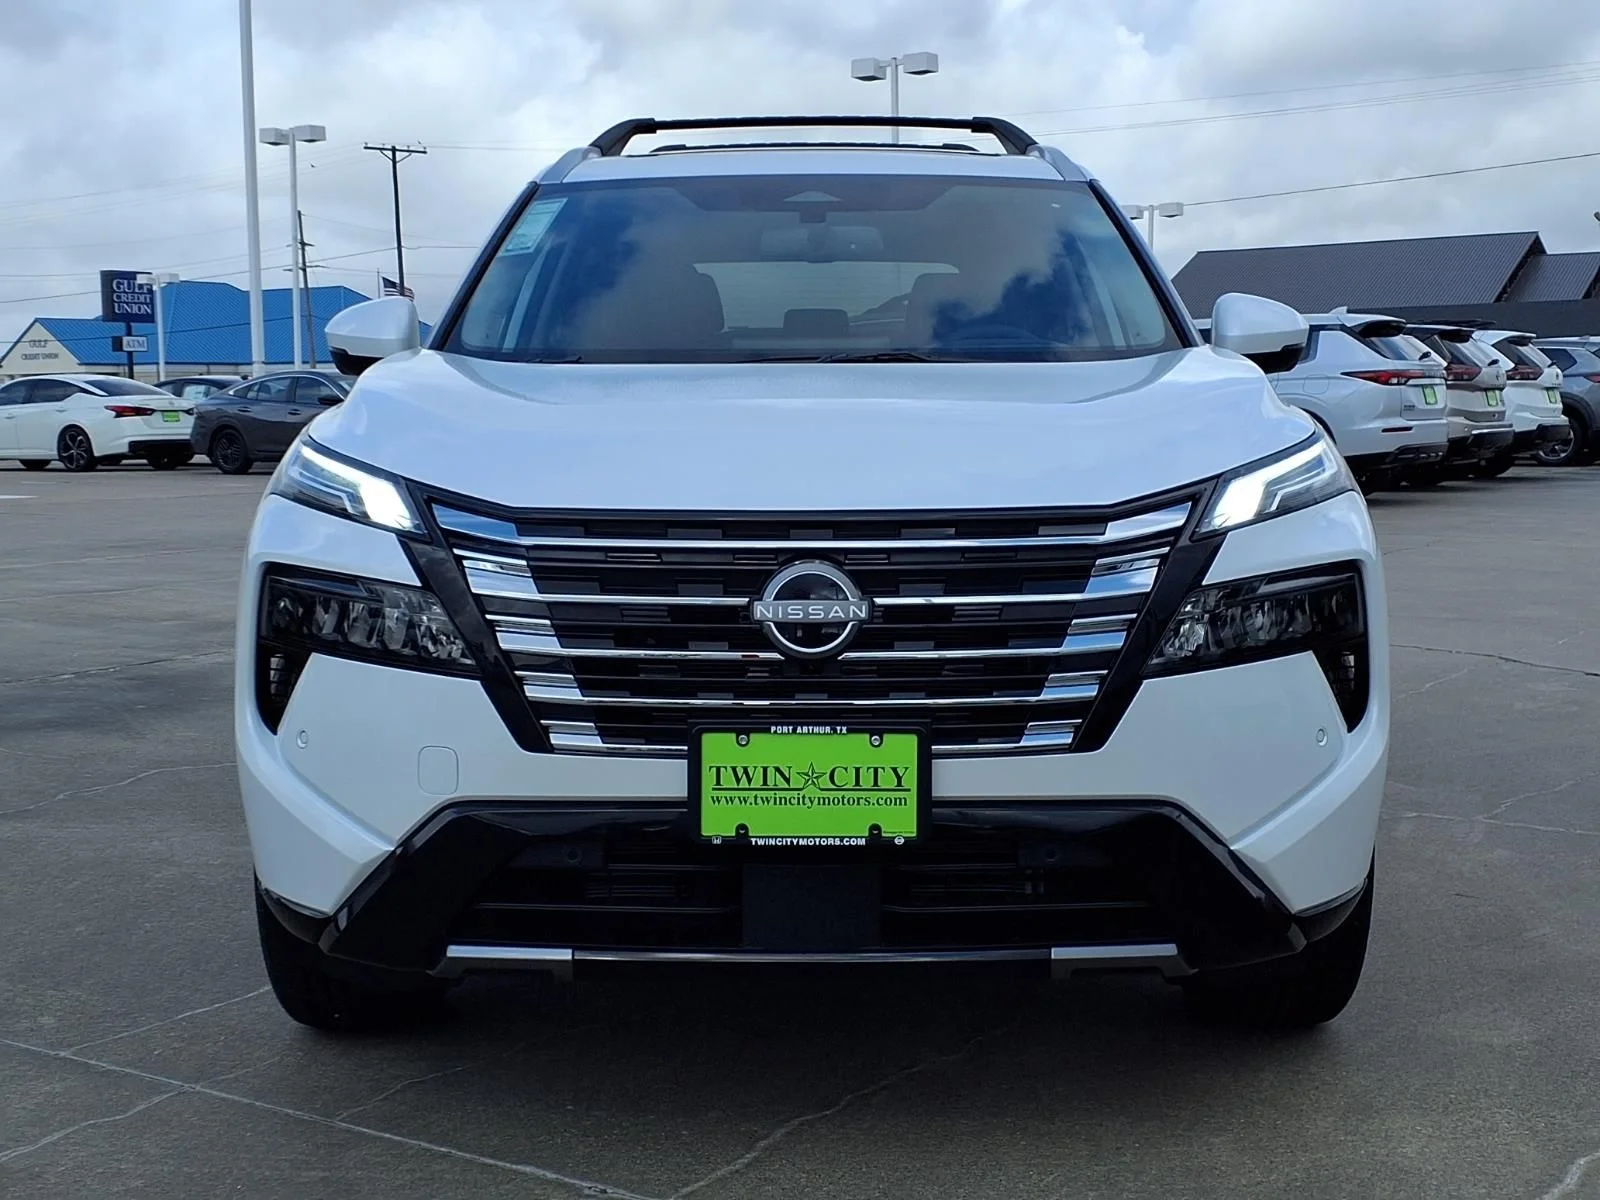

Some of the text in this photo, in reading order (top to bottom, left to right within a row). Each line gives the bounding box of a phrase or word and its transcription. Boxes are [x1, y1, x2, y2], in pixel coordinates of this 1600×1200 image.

[112, 278, 151, 293] GULF
[113, 292, 151, 303] CREDIT
[114, 303, 152, 314] UNION
[124, 340, 146, 349] ATM
[756, 605, 866, 619] NISSAN
[770, 726, 793, 734] PORT
[836, 726, 848, 734] TX
[709, 766, 910, 788] TWIN CITY
[710, 793, 908, 809] www.twincitymotors.com
[750, 837, 866, 846] TWINCITYMOTORS.COM
